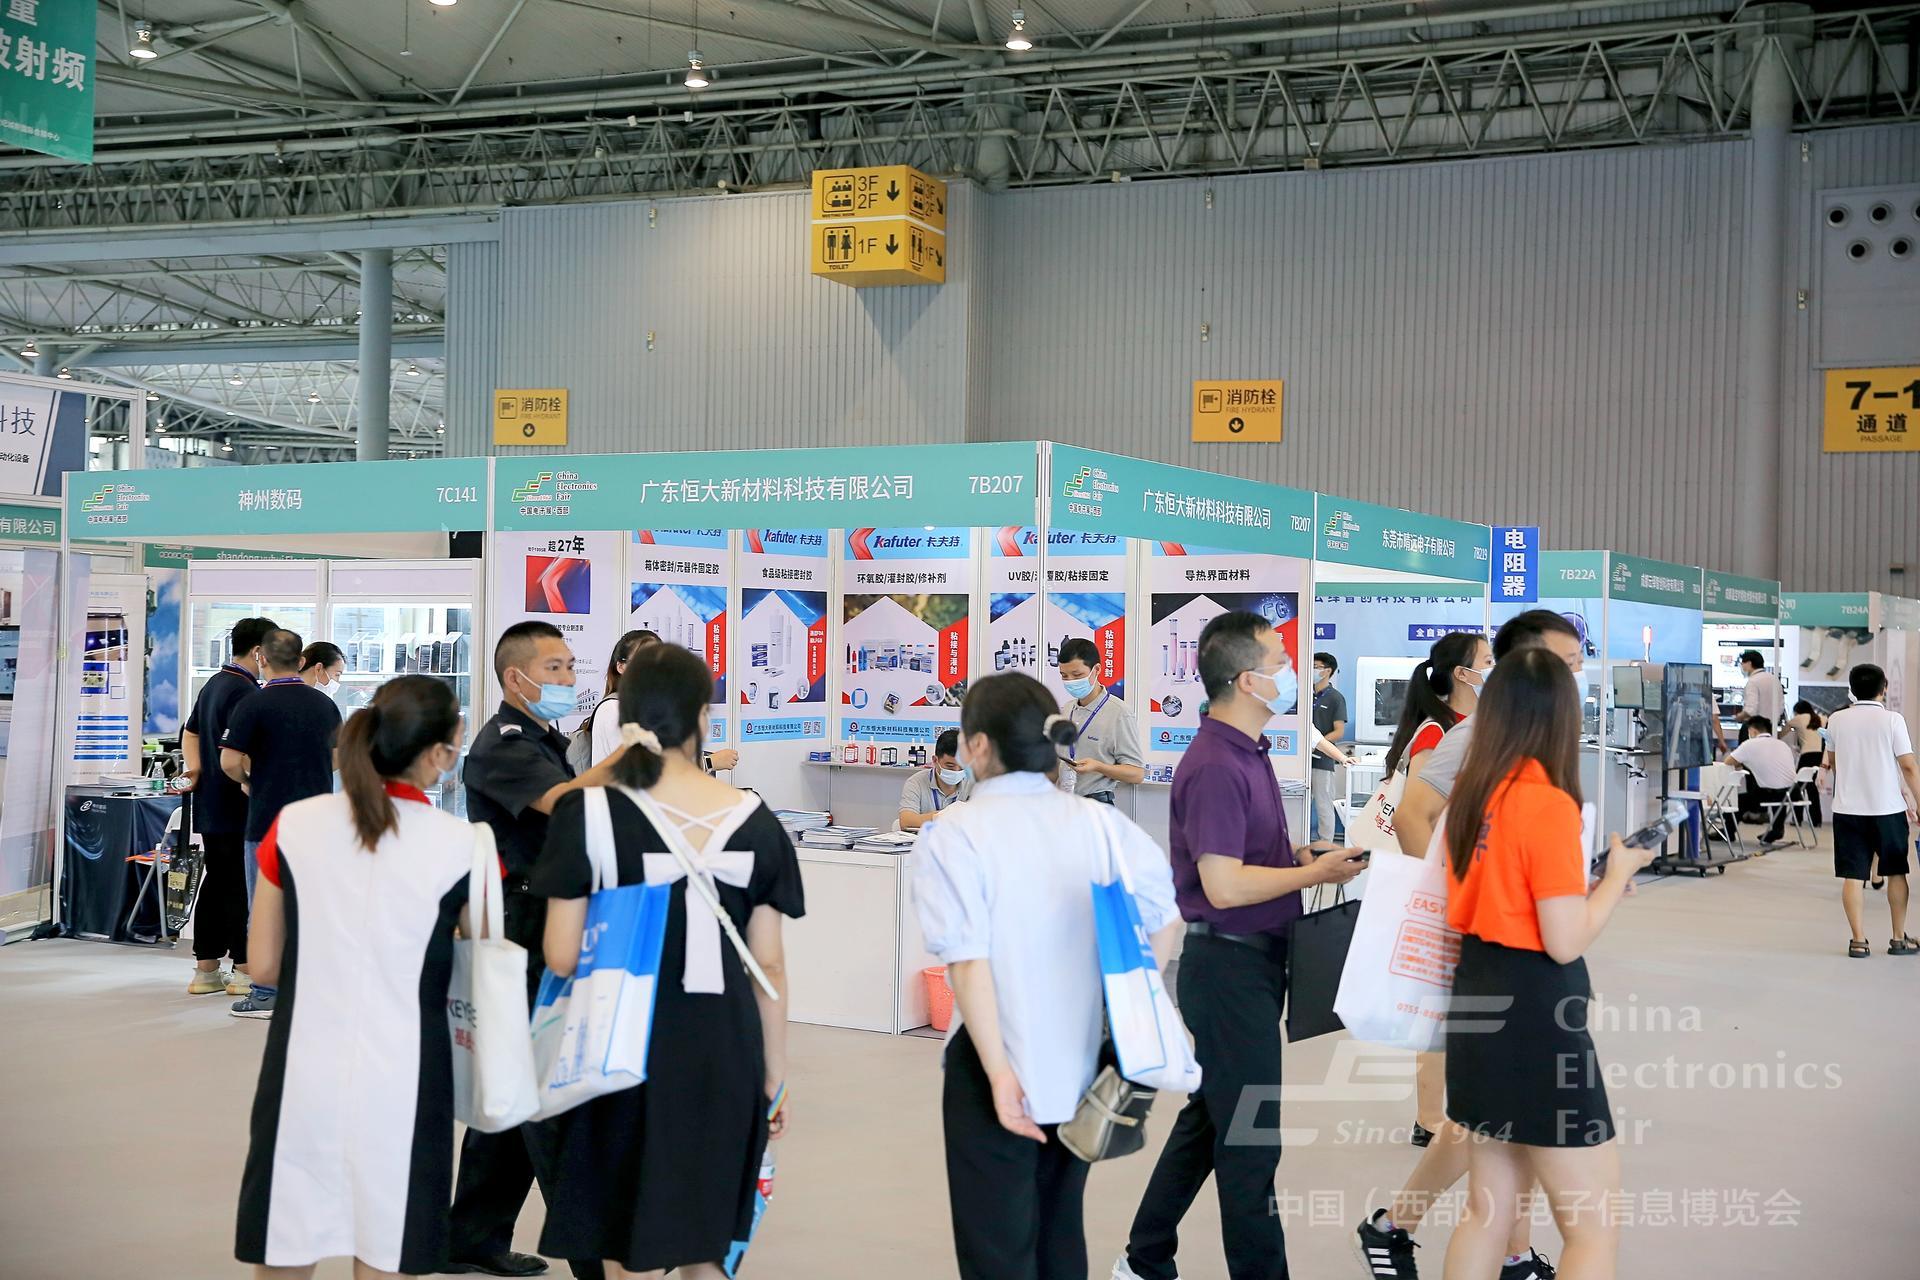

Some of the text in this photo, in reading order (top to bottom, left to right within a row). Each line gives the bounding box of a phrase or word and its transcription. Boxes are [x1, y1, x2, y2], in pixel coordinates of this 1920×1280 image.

[858, 175, 879, 191] 3F
[858, 193, 879, 209] 2F
[858, 238, 878, 254] 1F
[521, 397, 561, 412] 消防栓
[1226, 388, 1276, 405] 消防栓
[1856, 414, 1908, 433] 通道
[1860, 434, 1903, 443] PASSAGE
[556, 471, 578, 480] China
[556, 482, 597, 490] Electronics
[640, 475, 914, 504] 广东恒大新材料科技有限公司
[968, 475, 1024, 494] 7B207
[238, 489, 303, 511] 神州数码
[436, 487, 478, 504] 7C141
[556, 492, 571, 501] Fair
[1143, 488, 1271, 530] 广东恒大新材料科技有限公司
[0, 517, 57, 537] 有限公司
[1290, 515, 1311, 533] 7B207
[764, 529, 823, 546] Kafuter 卡夫特
[873, 535, 961, 548] Kafuter 卡夫特
[645, 559, 720, 575] 箱体密封/元器件固定胶
[1502, 528, 1527, 597] 电阻器
[762, 567, 812, 581] 食品级粘接密封胶
[857, 573, 947, 585] 环氧胶/灌封胶/修补剂
[1008, 570, 1109, 582] UV胶/覆胶/粘接固定
[1185, 569, 1250, 582] 导热界面材料
[1560, 569, 1597, 580] 7B22A
